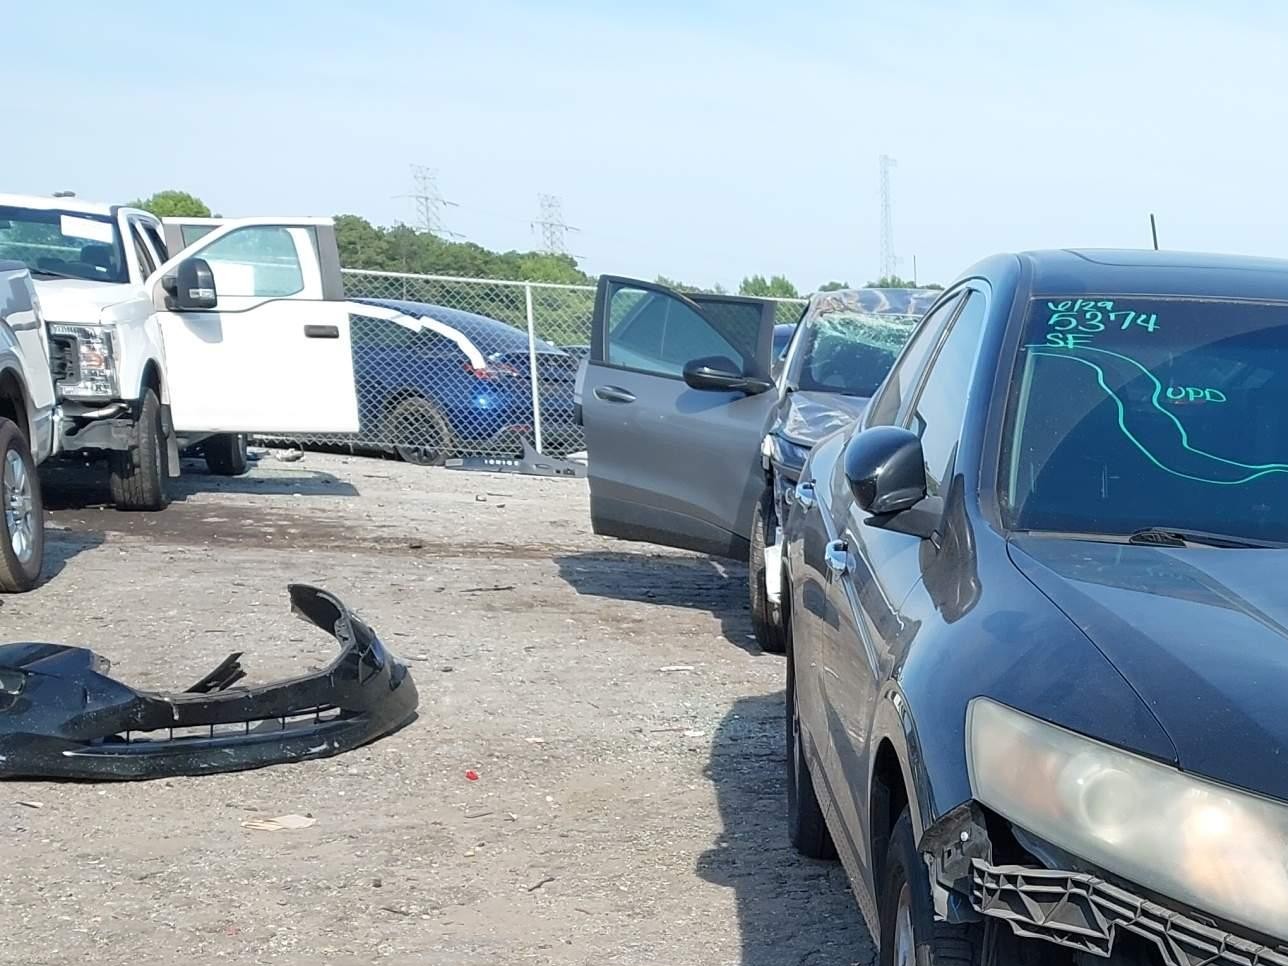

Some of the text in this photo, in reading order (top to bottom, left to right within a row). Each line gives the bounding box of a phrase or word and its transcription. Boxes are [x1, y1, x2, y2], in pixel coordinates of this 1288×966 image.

[1047, 311, 1160, 332] 5374
[1046, 332, 1095, 349] SF
[1166, 386, 1227, 403] UPD
